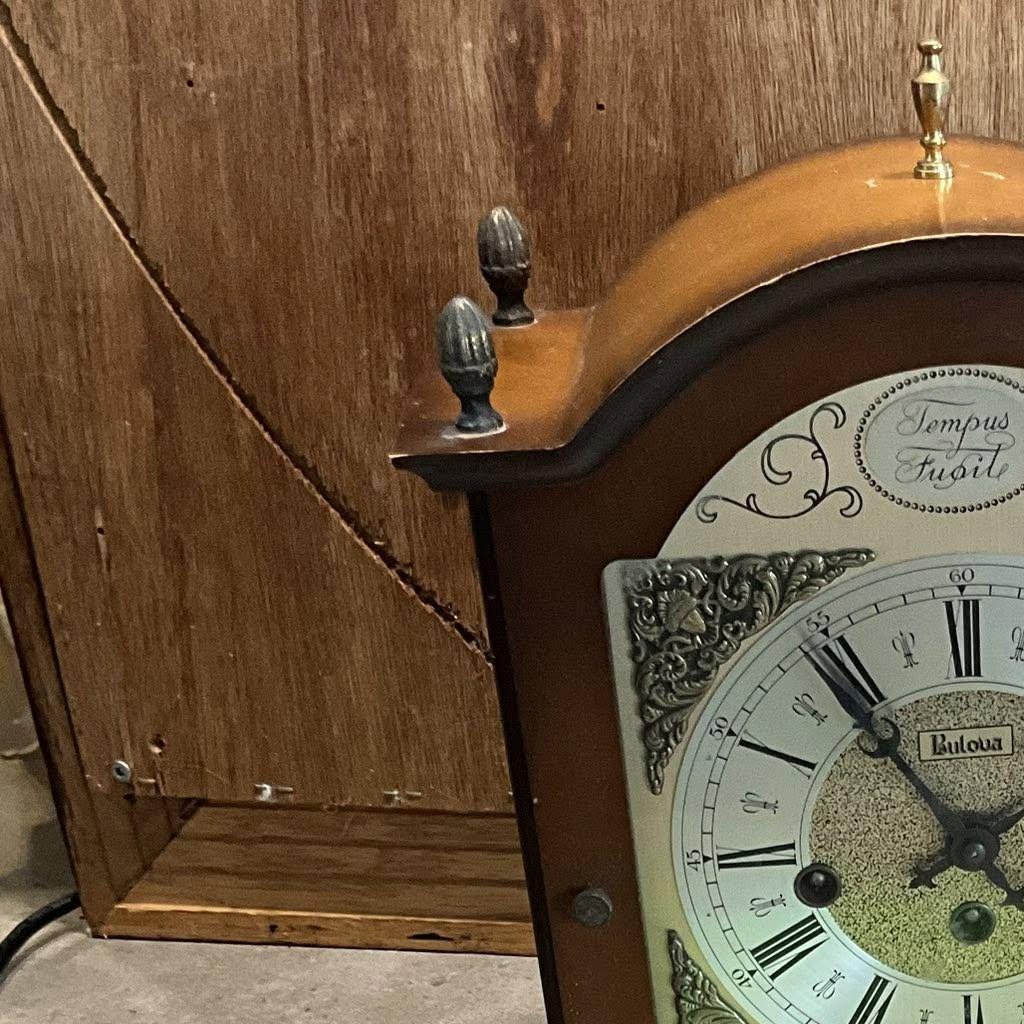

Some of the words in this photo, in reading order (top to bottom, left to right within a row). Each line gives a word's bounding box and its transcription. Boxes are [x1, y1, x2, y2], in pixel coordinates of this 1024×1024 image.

[896, 399, 1010, 459] Tempus
[895, 431, 1015, 490] Fugit
[948, 567, 975, 583] 60
[805, 610, 830, 633] 55
[943, 598, 982, 680] XII
[709, 716, 729, 741] 50
[736, 729, 820, 780] X
[930, 733, 1003, 756] Bulova
[686, 849, 701, 872] 45
[716, 839, 797, 870] IX
[750, 911, 832, 983] VIII
[731, 968, 752, 990] 40
